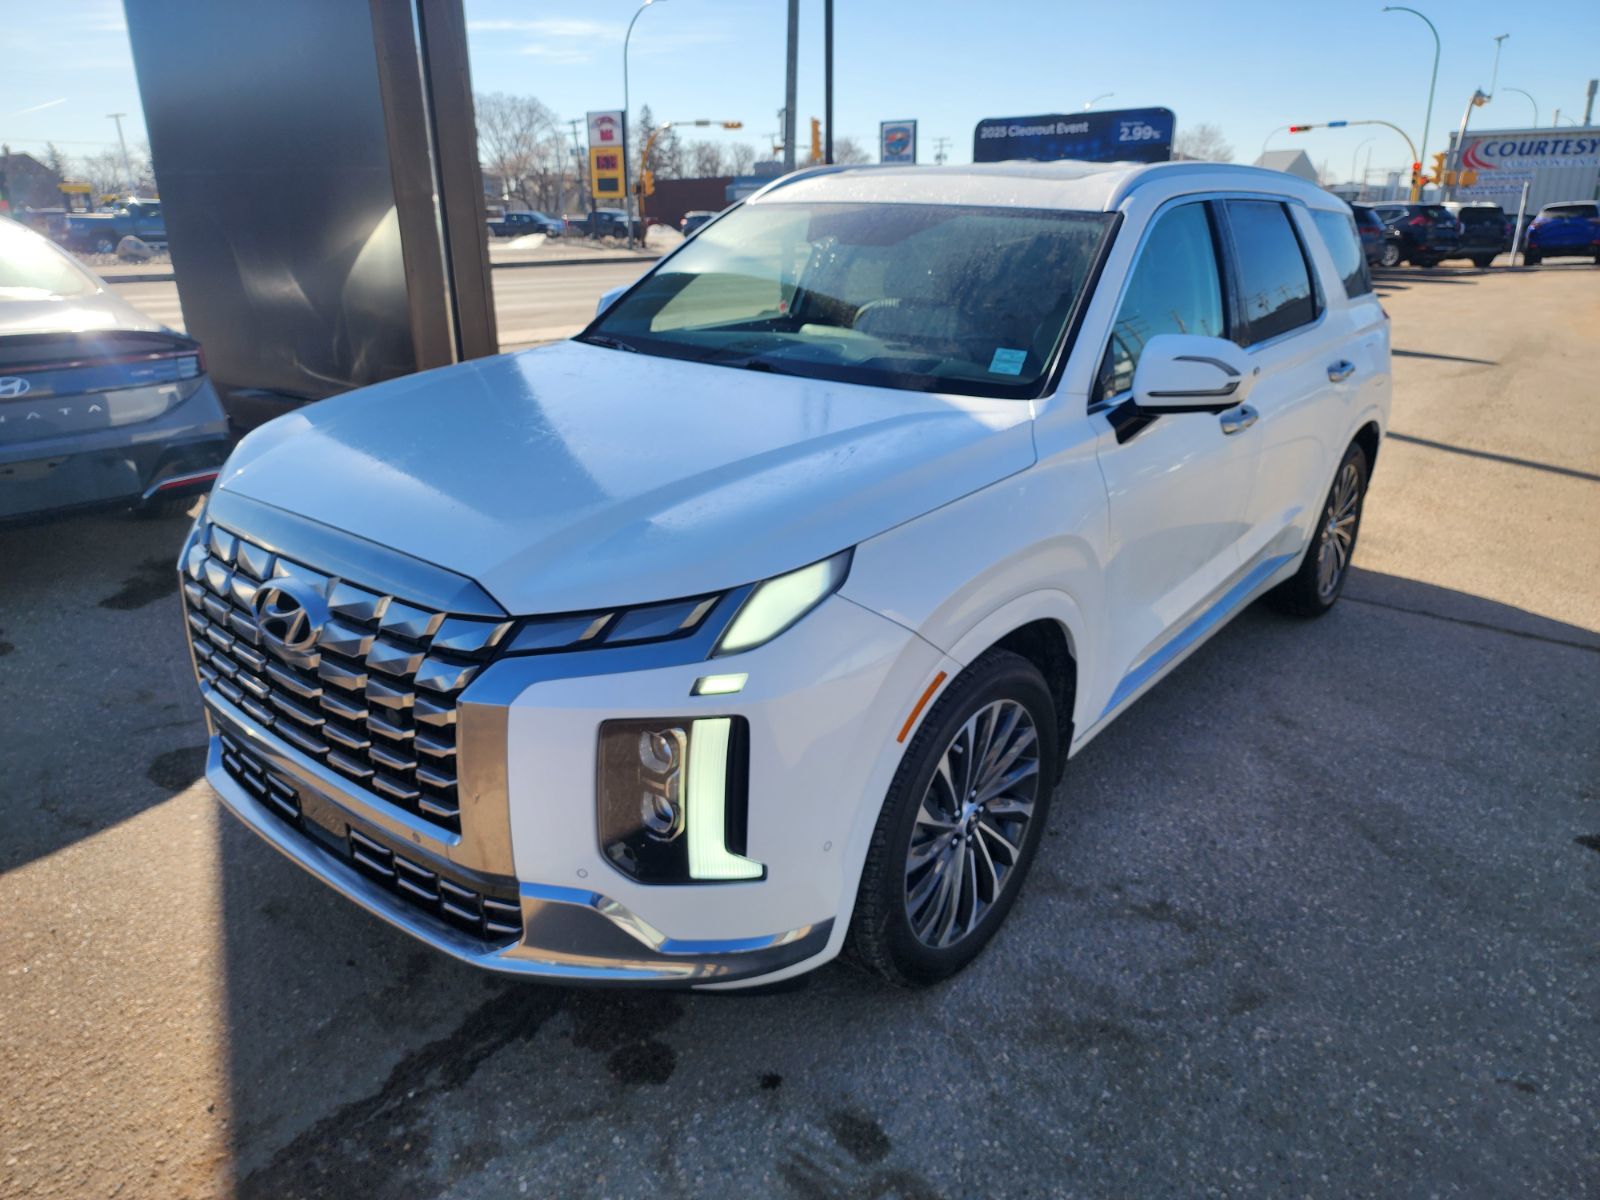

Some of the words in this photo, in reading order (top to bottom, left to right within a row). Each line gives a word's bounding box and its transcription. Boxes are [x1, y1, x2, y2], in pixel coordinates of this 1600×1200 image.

[1007, 123, 1056, 137] Clearout
[1056, 121, 1089, 134] Event
[1484, 139, 1600, 157] COURTESY
